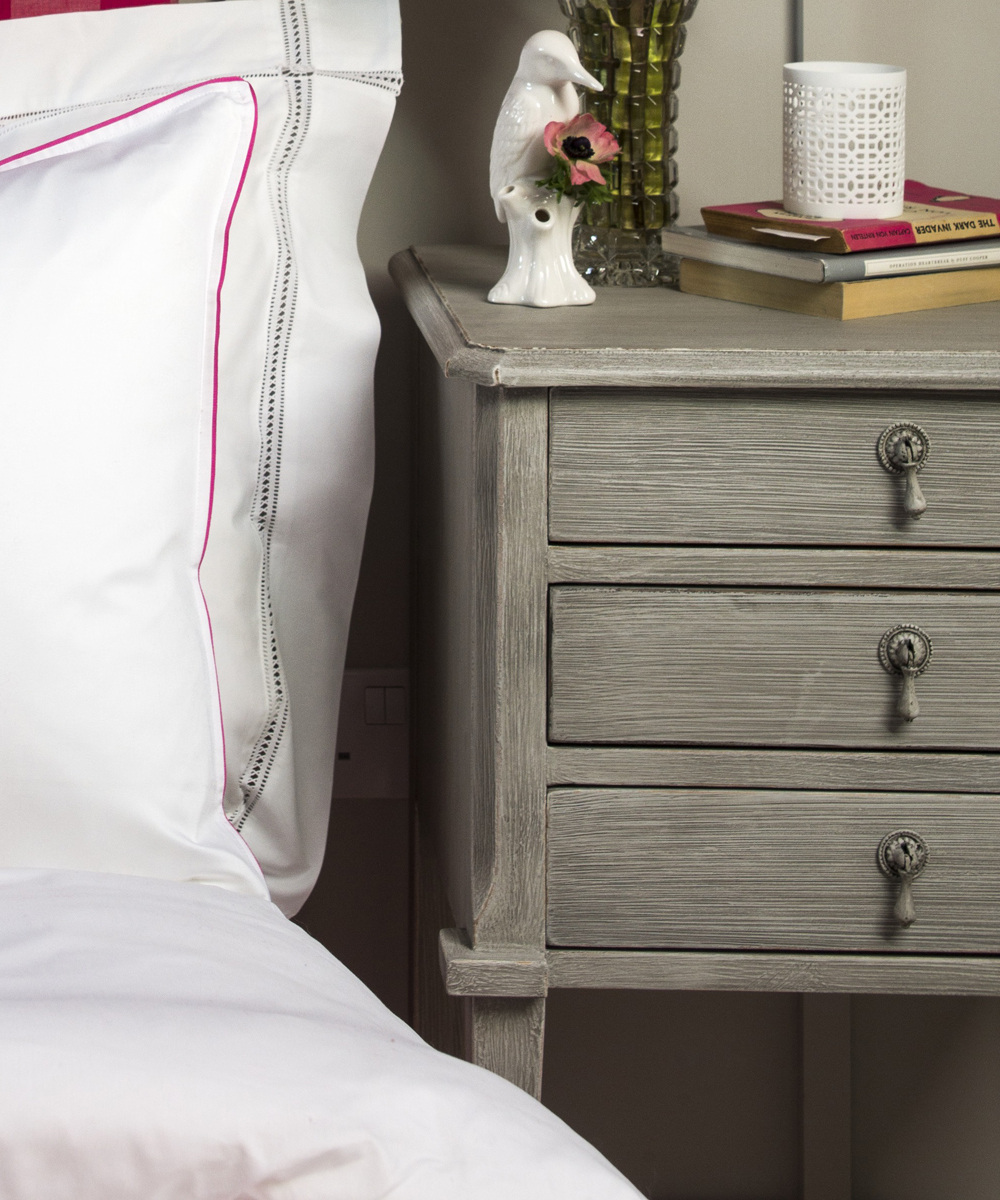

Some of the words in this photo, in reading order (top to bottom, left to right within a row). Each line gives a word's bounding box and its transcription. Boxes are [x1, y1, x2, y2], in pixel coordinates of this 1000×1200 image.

[954, 220, 976, 231] DARK
[978, 218, 996, 228] THE
[888, 228, 911, 237] CAPTAIN
[914, 222, 952, 235] INVADER
[851, 232, 875, 241] RINTELEN
[918, 258, 949, 266] HEARTBREAK
